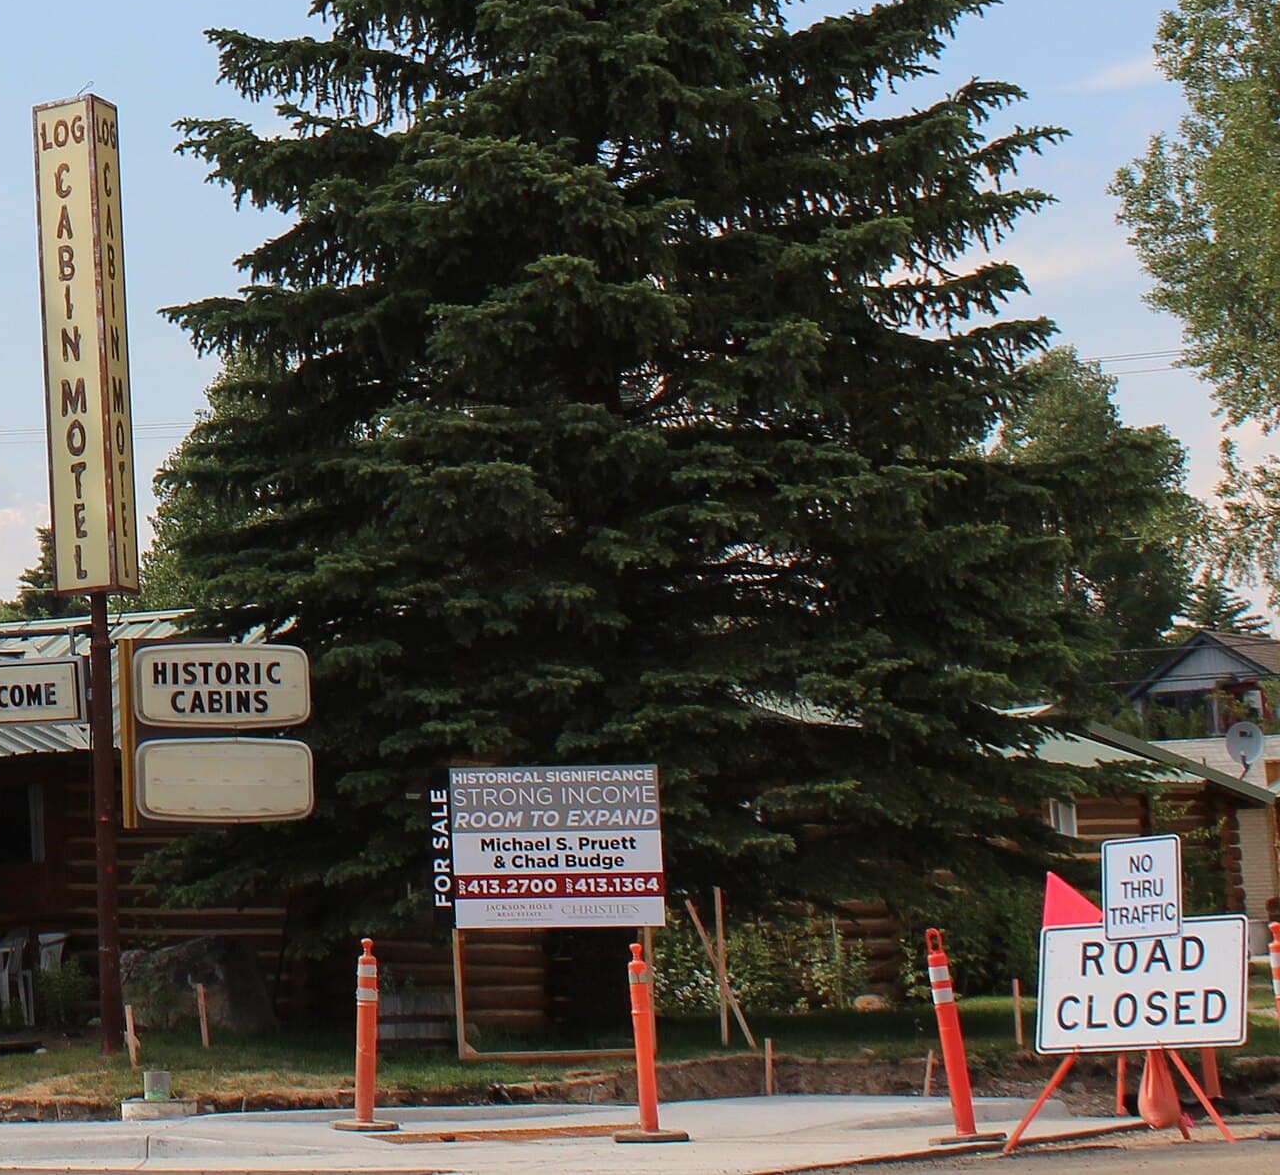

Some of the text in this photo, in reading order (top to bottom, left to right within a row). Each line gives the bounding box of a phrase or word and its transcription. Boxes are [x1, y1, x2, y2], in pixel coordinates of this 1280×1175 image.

[40, 114, 85, 151] LOG
[95, 114, 117, 150] LOG
[54, 162, 82, 362] CABIN
[102, 162, 120, 362] CABIN
[61, 377, 88, 580] MOTEL
[111, 376, 130, 579] MOTEL
[152, 660, 282, 686] HISTORIC
[171, 689, 269, 715] CABINS
[452, 769, 654, 785] HISTORICAL SIGNIFICANCE
[453, 785, 657, 807] STRONG INCOME
[454, 809, 658, 828] ROOM TO EXPAND
[430, 789, 452, 907] FOR SALE
[480, 836, 637, 851] Michael S. Pruett
[493, 853, 625, 870] & Chad Budge
[1129, 854, 1153, 874] NO
[467, 879, 557, 894] 413.2700
[575, 877, 659, 892] 413.1364
[1120, 878, 1164, 899] THRU
[1109, 902, 1176, 926] TRAFFIC
[1080, 935, 1205, 976] ROAD
[1056, 989, 1228, 1031] CLOSED
